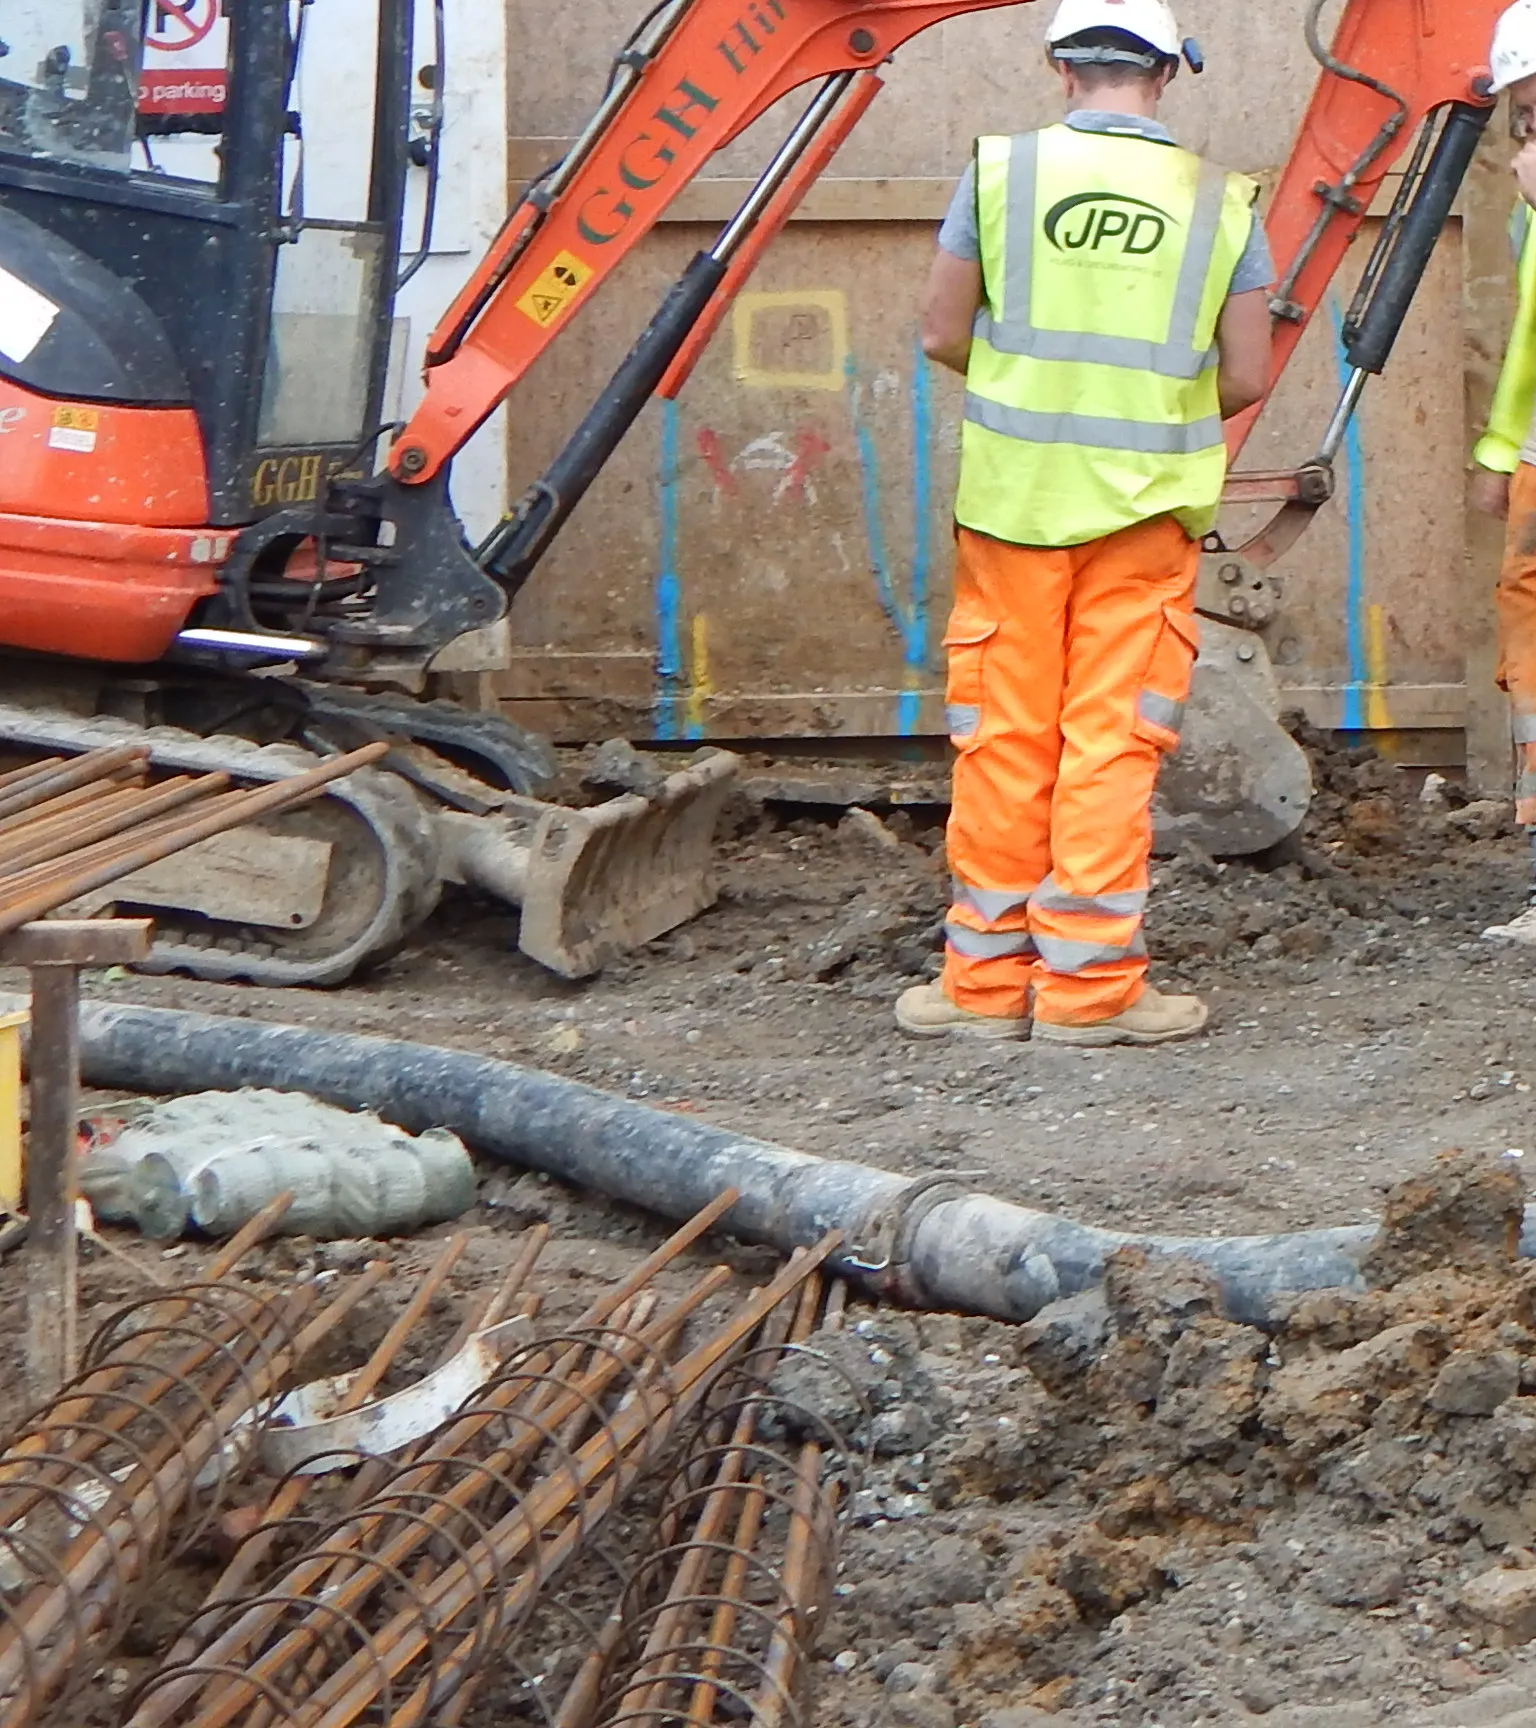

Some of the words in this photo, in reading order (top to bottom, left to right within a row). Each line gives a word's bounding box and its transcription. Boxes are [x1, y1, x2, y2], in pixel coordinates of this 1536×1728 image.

[152, 80, 226, 104] parking
[576, 76, 722, 245] GGH
[1063, 207, 1166, 255] JPD
[253, 454, 323, 506] GGH
